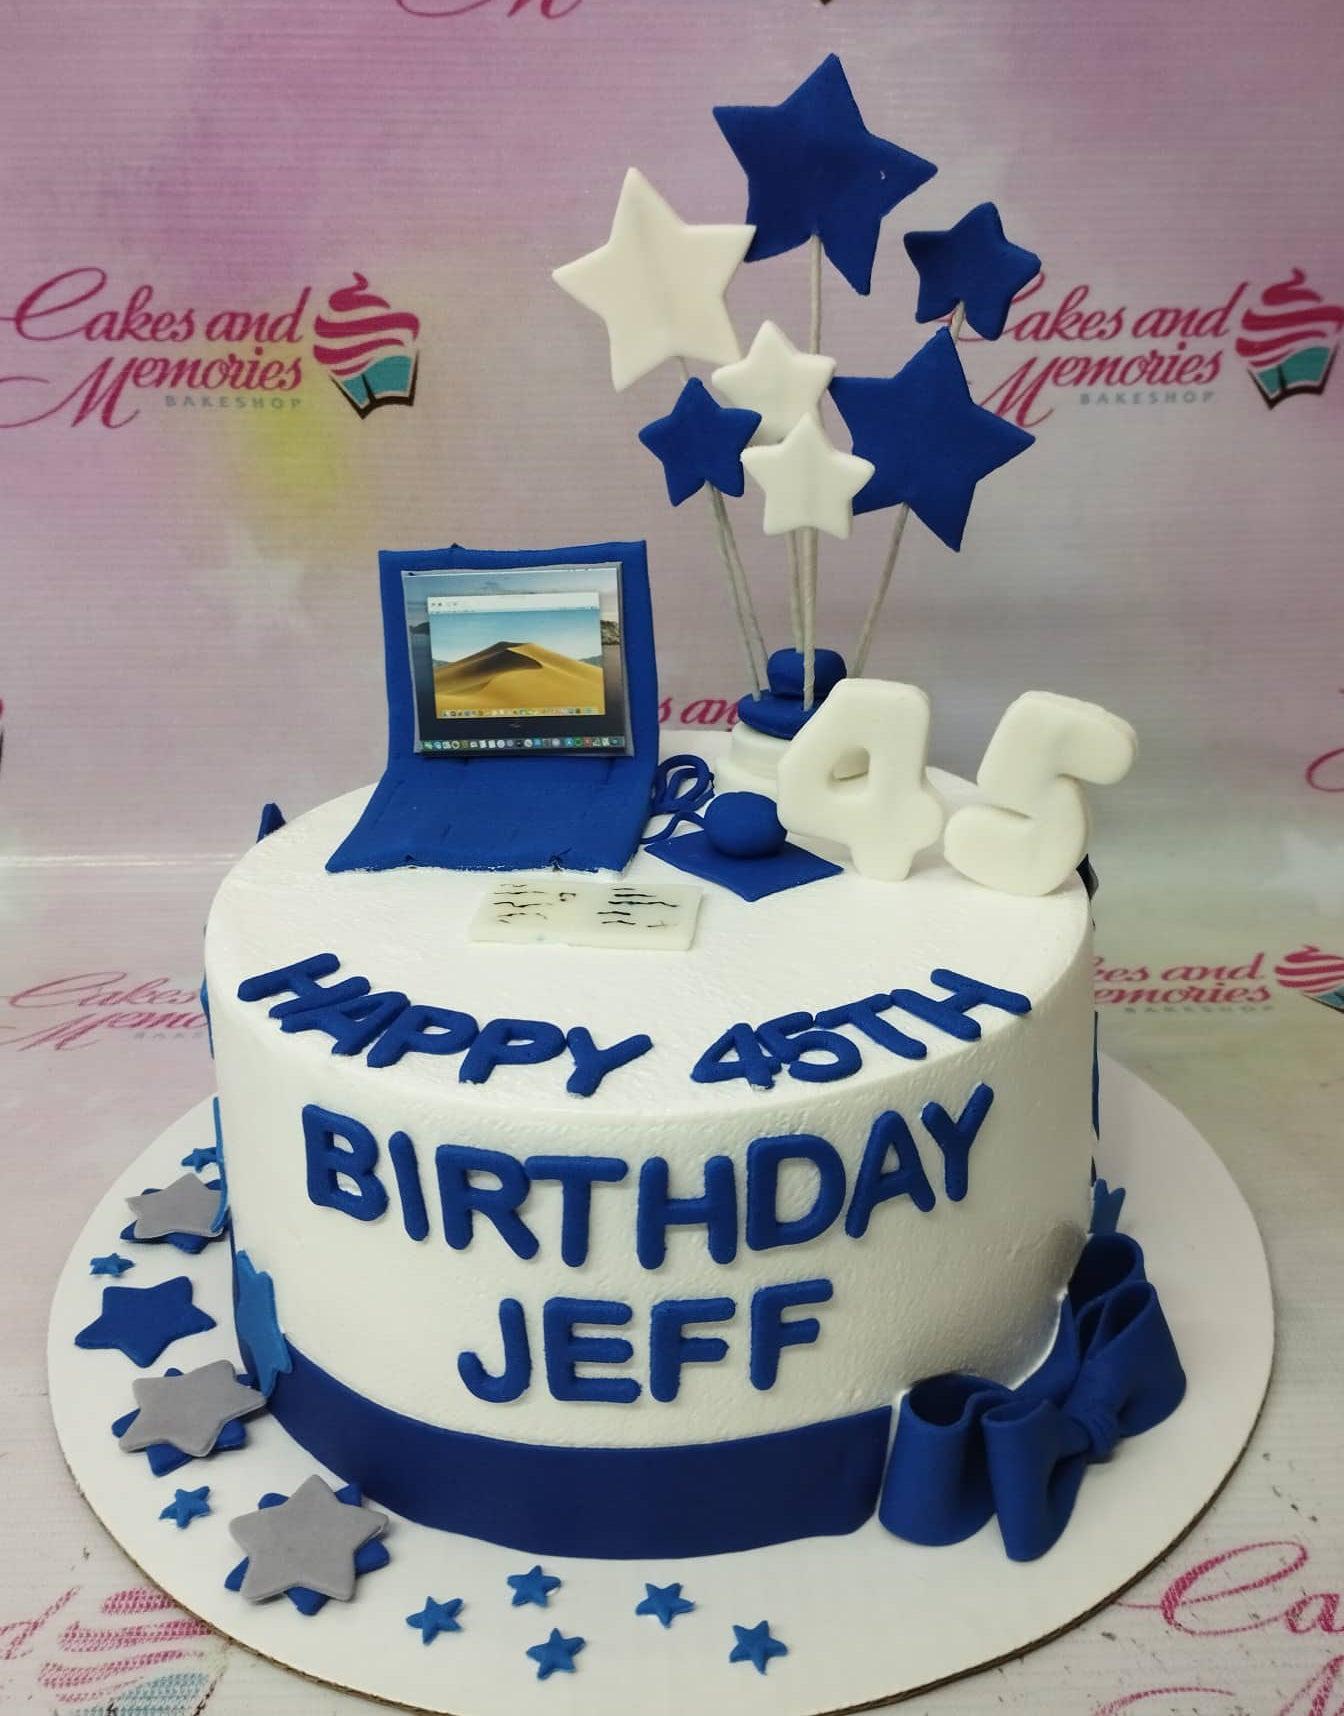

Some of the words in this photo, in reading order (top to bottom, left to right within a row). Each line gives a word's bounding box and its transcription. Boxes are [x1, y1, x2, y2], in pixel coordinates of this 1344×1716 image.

[0, 267, 195, 342] Cakes
[205, 286, 312, 343] and
[950, 271, 1124, 342] akes
[1131, 281, 1249, 338] and
[0, 346, 303, 429] Memories
[164, 394, 302, 410] BAKESHOP
[1079, 390, 1216, 407] BAKESHOP
[776, 678, 1138, 896] 45
[8, 971, 196, 1008] Cakes
[1093, 981, 1271, 1004] emories
[1160, 951, 1265, 981] and
[237, 952, 654, 1098] HAPPY
[690, 967, 1032, 1090] 45TH
[301, 1083, 995, 1271] BIRTHDAY
[457, 1278, 834, 1404] JEFF
